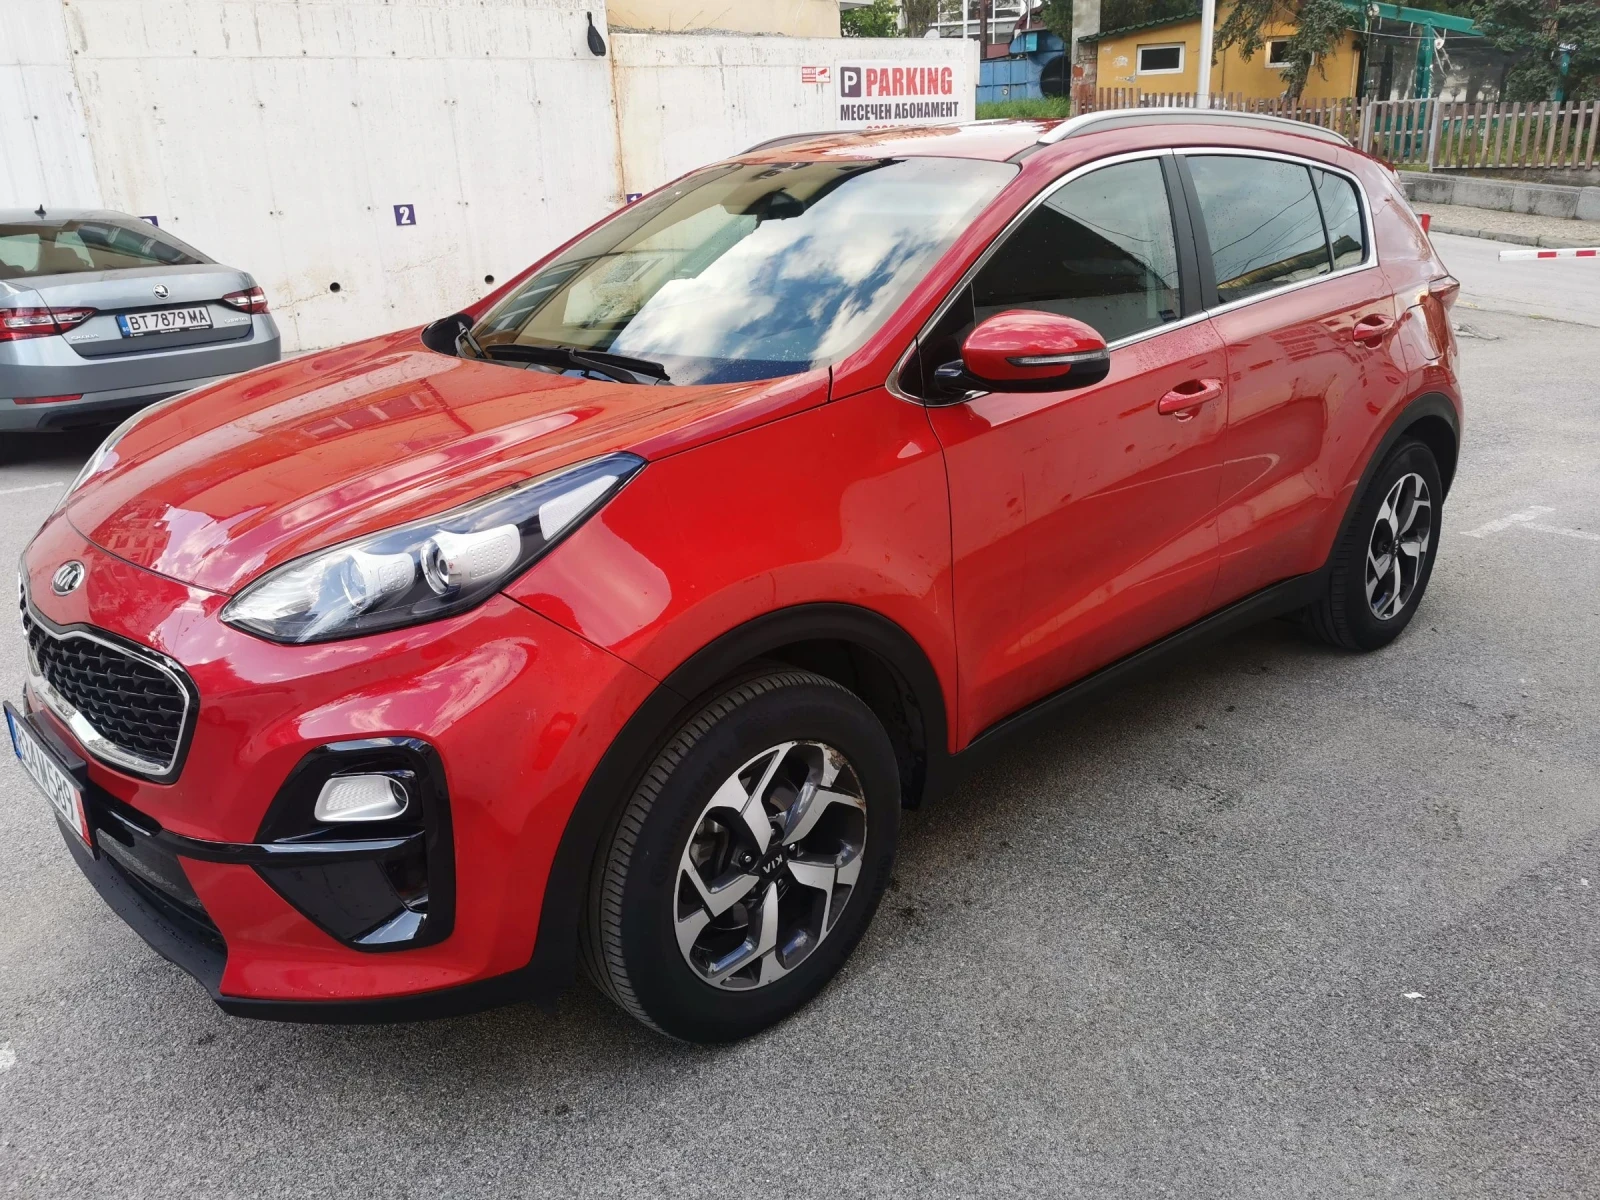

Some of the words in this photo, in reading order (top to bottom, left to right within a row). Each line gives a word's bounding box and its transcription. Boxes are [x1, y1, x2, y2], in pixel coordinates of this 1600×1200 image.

[866, 67, 952, 97] PARKING
[840, 103, 892, 121] МЕСЕЧЕН
[894, 101, 959, 120] АБОНАМЕНТ
[399, 206, 411, 224] 2
[763, 854, 783, 874] KIA
